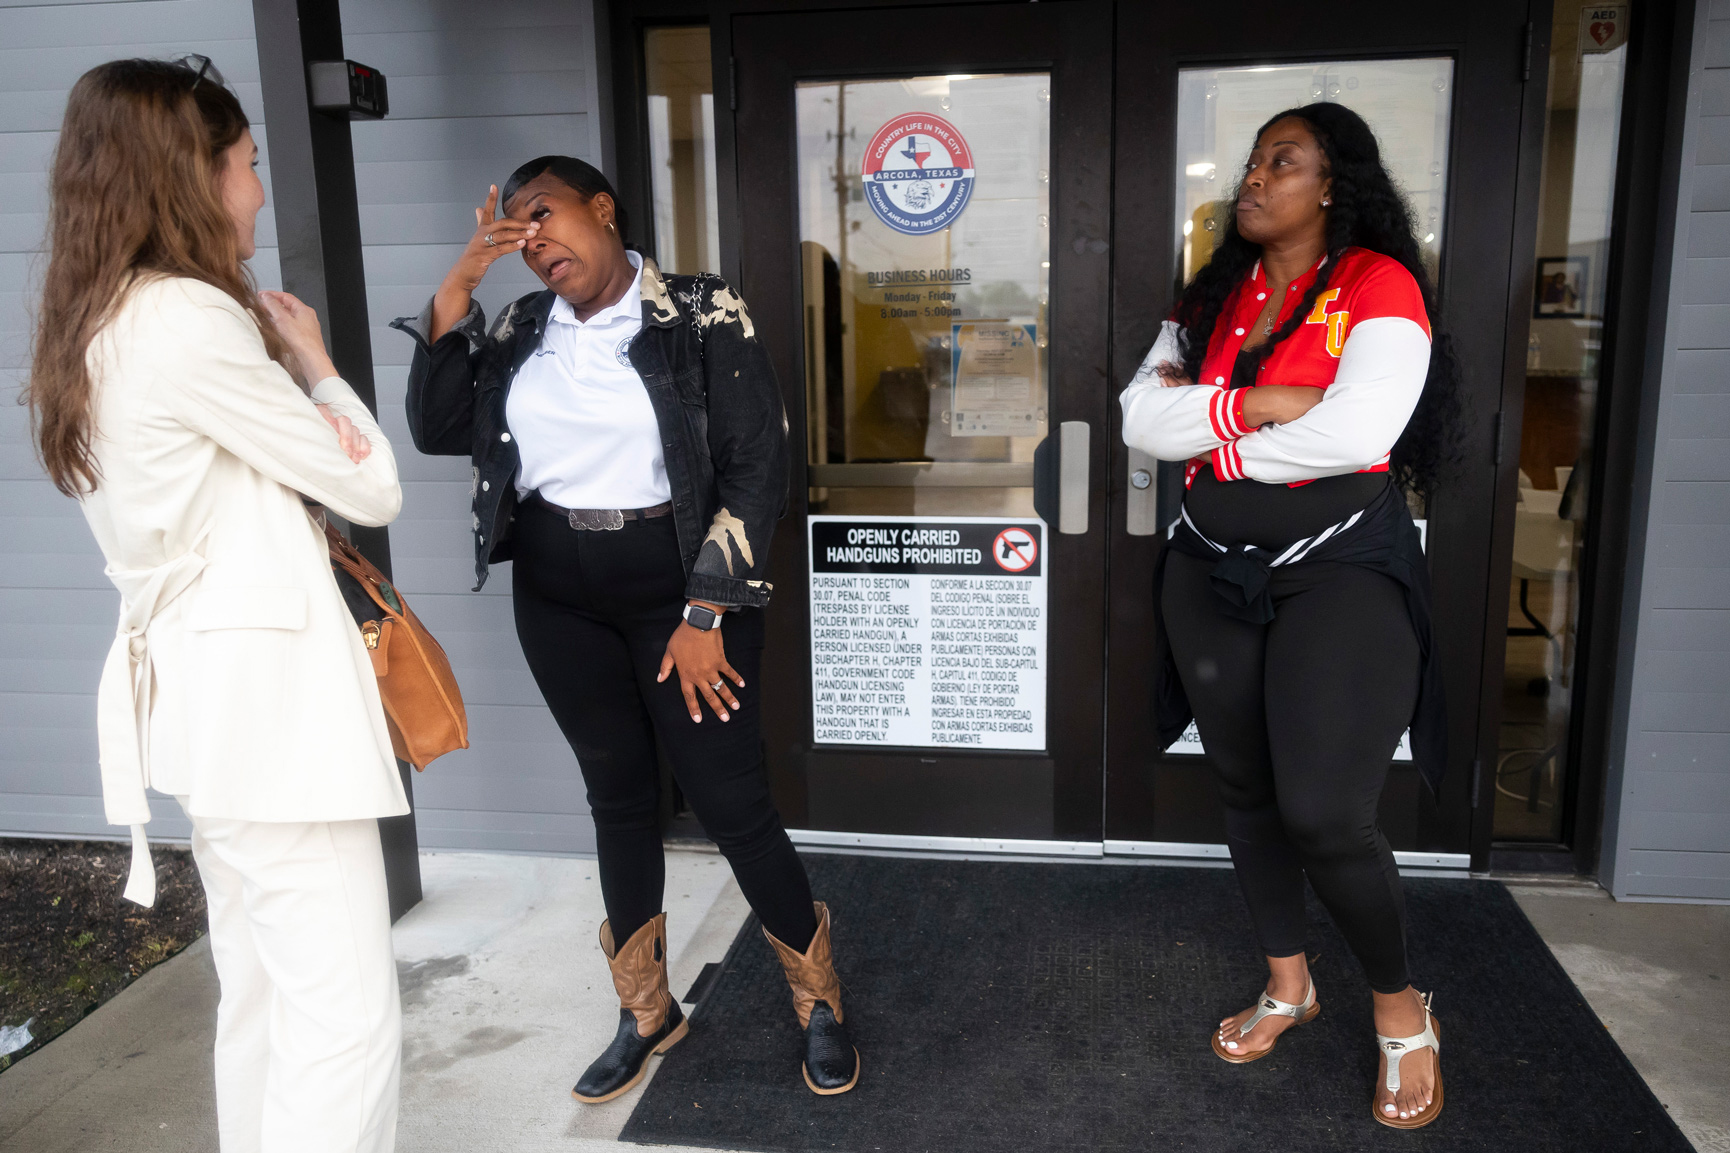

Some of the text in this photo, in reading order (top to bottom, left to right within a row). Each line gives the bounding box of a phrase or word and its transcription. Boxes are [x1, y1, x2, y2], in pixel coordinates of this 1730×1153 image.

[1592, 11, 1616, 19] AED
[876, 123, 962, 159] COUNTRY LIFE IN THE CITY
[876, 169, 958, 180] ARCOLA, TEXAS
[872, 186, 888, 213] MOVING
[887, 212, 910, 226] AHEAD
[920, 219, 933, 227] THE
[934, 213, 947, 223] 21ST
[947, 183, 966, 213] CENTURY
[868, 268, 971, 284] BUSINESS HOURS
[884, 292, 920, 303] Monday
[929, 291, 956, 302] Friday
[881, 308, 917, 318] 8:00am
[925, 307, 961, 317] 5:00pm
[847, 529, 960, 545] OPENLY CARRIED
[827, 547, 981, 564] HANDGUNS PROHIBITED
[813, 577, 909, 589] PURSUANT TO SECTION
[931, 579, 967, 590] CONFORME
[970, 580, 975, 590] A
[975, 580, 984, 590] LA
[813, 591, 890, 602] 30.07, PENAL CODE
[931, 592, 943, 602] DEL
[973, 593, 994, 603] PENAL
[996, 593, 1020, 606] (SOBRE
[1022, 594, 1030, 604] EL
[813, 603, 909, 616] (TRESPASS BY LICENSE
[931, 605, 960, 616] INGRESO
[986, 606, 994, 616] DE
[996, 607, 1005, 617] UN
[1007, 607, 1040, 617] INDIVIDUO
[814, 616, 919, 628] HOLDER WITH AN OPENLY
[931, 619, 945, 629] CON
[947, 619, 976, 629] LICENCIA
[978, 619, 986, 629] DE
[1028, 620, 1036, 630] DE
[814, 629, 850, 639] CARRIED
[901, 631, 907, 640] A
[931, 632, 1018, 642] ARMAS CORTAS EXHIBIDAS
[814, 642, 922, 653] PERSON LICENSED UNDER
[985, 645, 1020, 656] PERSONAS
[1022, 646, 1036, 656] CON
[815, 654, 922, 667] SUBCHAPTER H, CHAPTER
[931, 657, 961, 667] LICENCIA
[962, 658, 979, 668] BAJO
[981, 658, 993, 668] DEL
[815, 668, 915, 679] 411, GOVERNMENT CODE
[1008, 672, 1017, 681] DE
[815, 680, 904, 692] (HANDGUN LICENSING
[931, 683, 965, 692] GOBIERNO
[983, 684, 991, 693] DE
[993, 684, 1019, 694] PORTAR
[840, 693, 857, 702] MAY
[860, 693, 876, 703] NOT
[879, 694, 905, 704] ENTER
[960, 696, 978, 706] TIENE
[980, 696, 1015, 707] PROHIBIDO
[816, 705, 910, 717] THIS PROPERTY WITH A
[932, 708, 1031, 720] INGRESAR EN ESTA PROPIEDAD
[816, 717, 889, 728] HANDGUN THAT IS
[932, 720, 1033, 733] CON ARMAS CORTAS EXHIBIDAS
[816, 730, 888, 741] CARRIED OPENLY.
